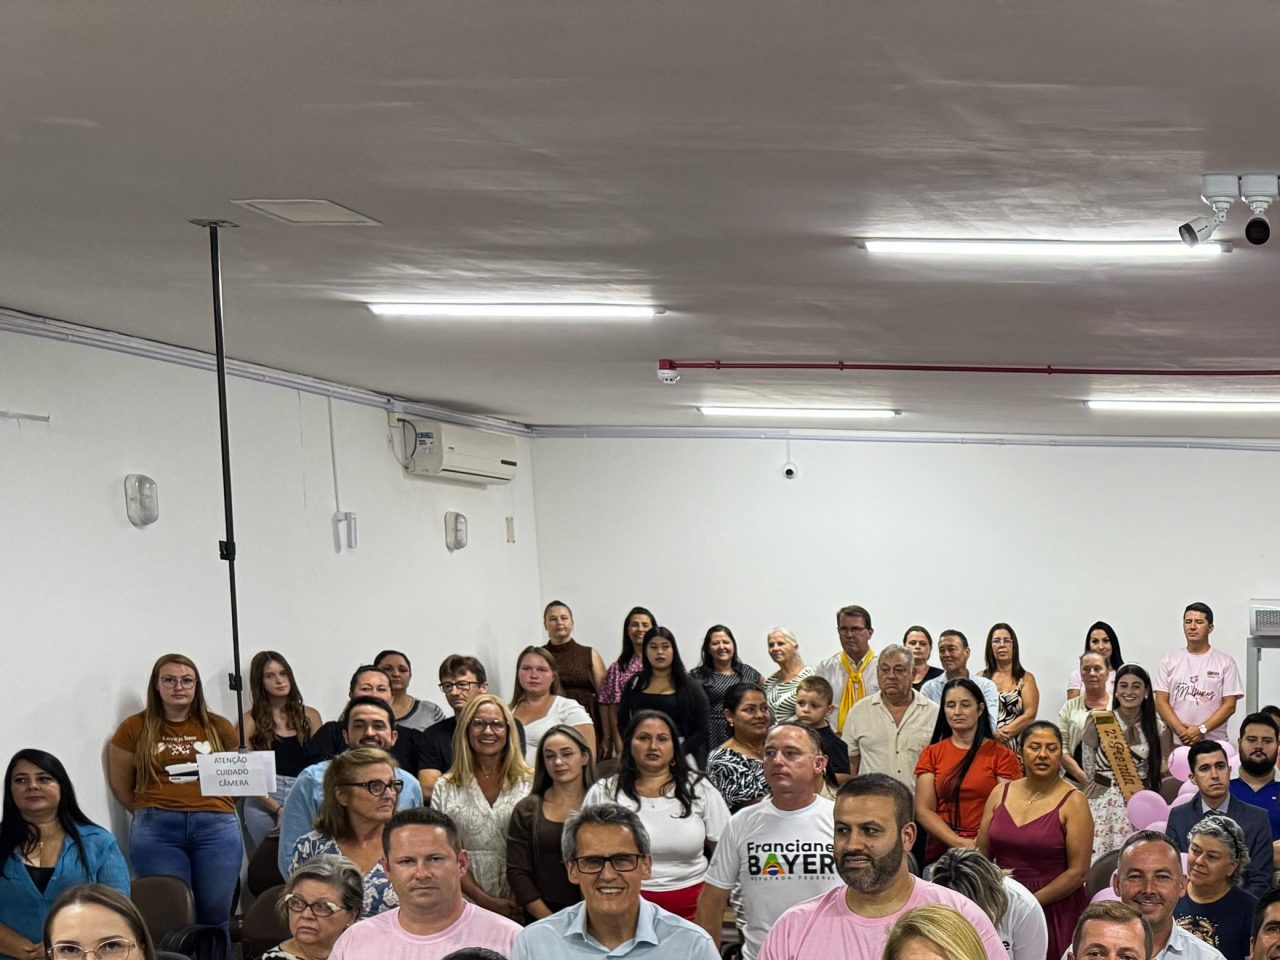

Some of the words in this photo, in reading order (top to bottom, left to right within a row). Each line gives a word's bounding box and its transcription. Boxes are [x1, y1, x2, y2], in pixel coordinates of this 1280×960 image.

[214, 757, 248, 765] ATENÇÃO
[216, 768, 248, 776] CUIDADO
[219, 779, 250, 787] CÂMERA
[747, 840, 835, 854] Franciane
[748, 853, 835, 876] BAYER
